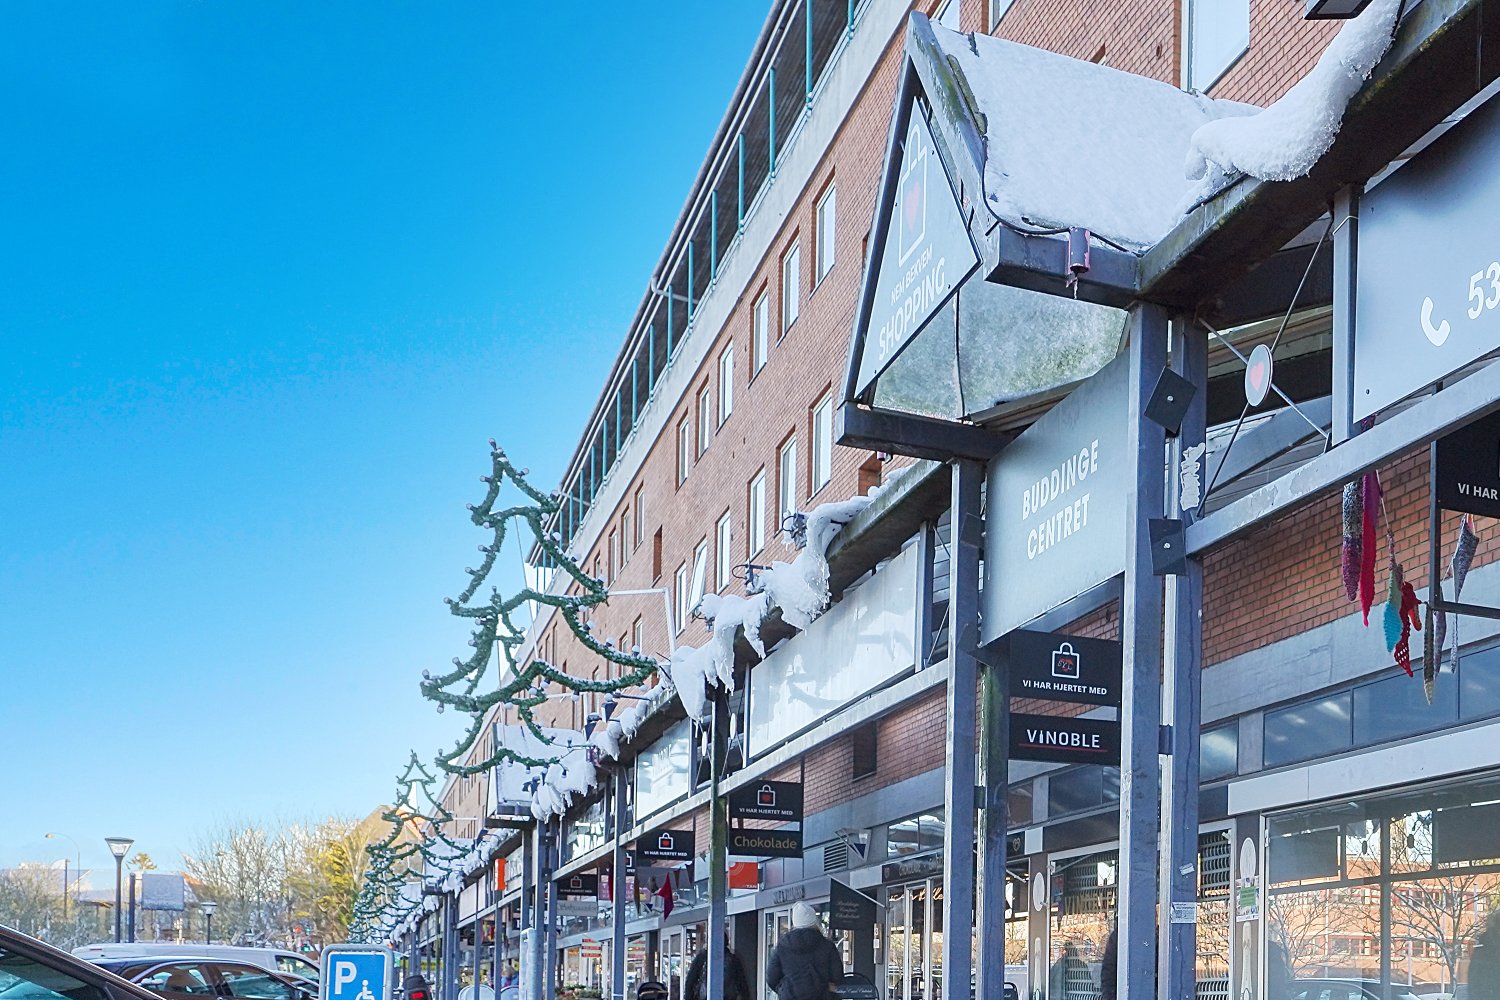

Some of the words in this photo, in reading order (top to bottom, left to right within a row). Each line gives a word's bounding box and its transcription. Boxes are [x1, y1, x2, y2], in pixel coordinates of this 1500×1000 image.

[891, 280, 905, 306] NEM
[905, 243, 933, 291] BEKVEM
[879, 256, 945, 361] SHOPPING
[1022, 439, 1099, 520] BUDDINGE
[1457, 483, 1469, 495] VI
[1474, 486, 1498, 500] HAR
[1027, 493, 1090, 560] CENTRET
[1034, 681, 1051, 690] HAR
[1053, 683, 1087, 693] HJERTET
[1089, 687, 1107, 695] MED
[734, 836, 797, 849] Chokolade
[335, 961, 357, 995] P
